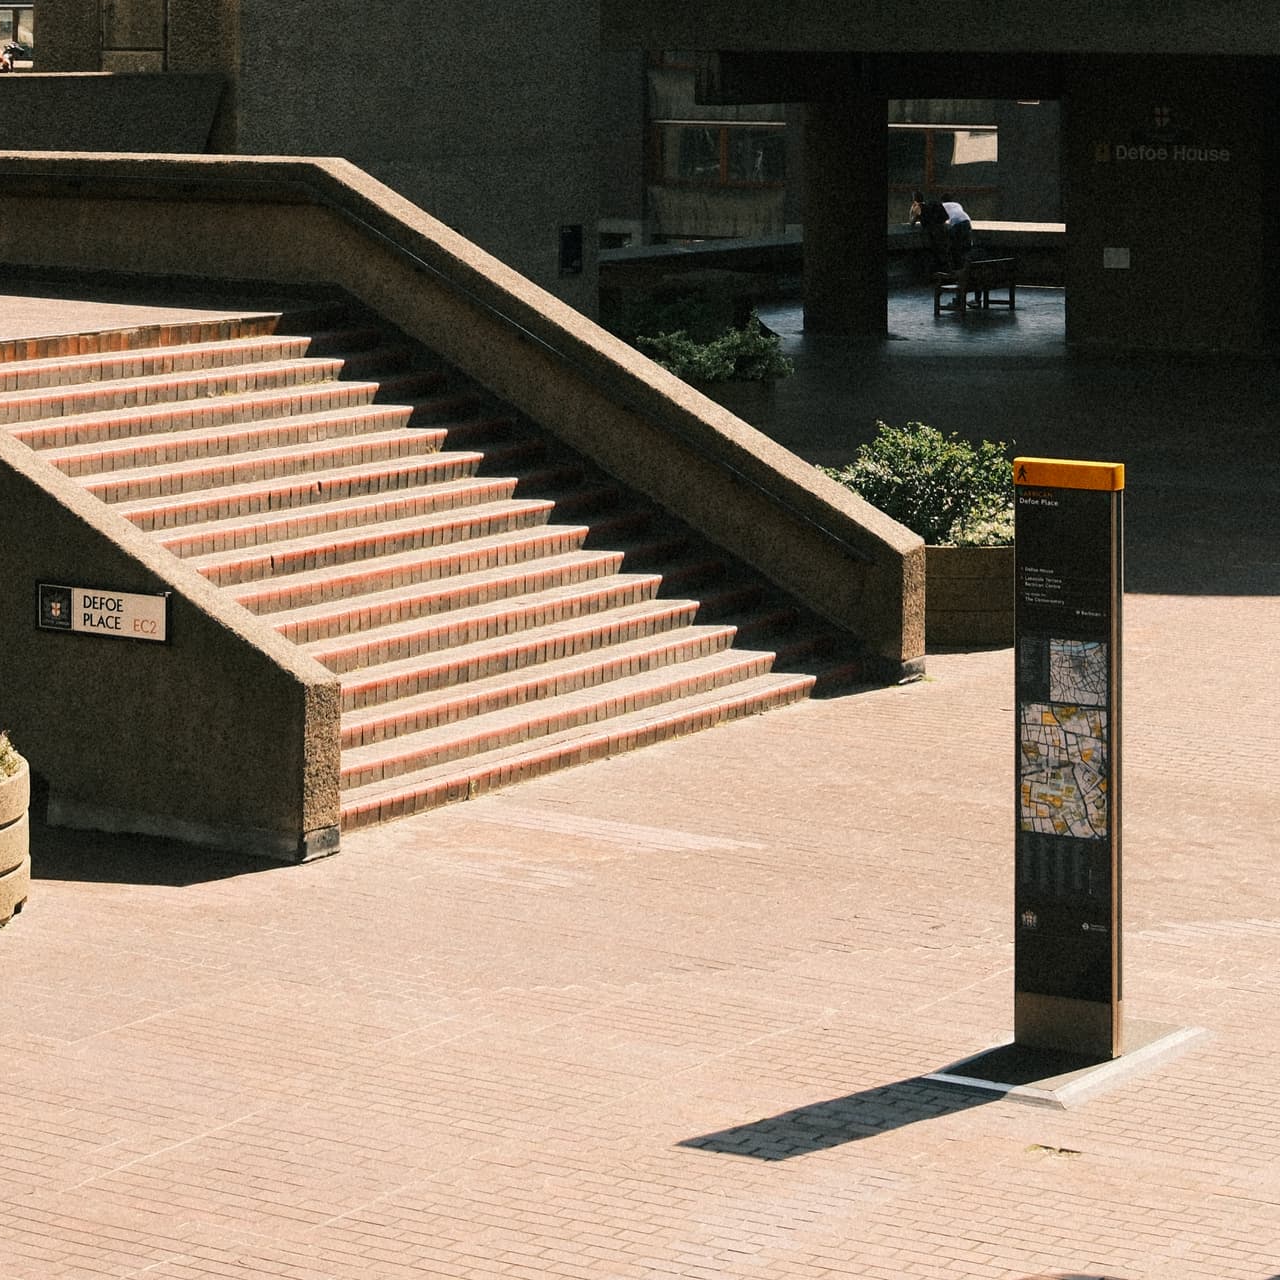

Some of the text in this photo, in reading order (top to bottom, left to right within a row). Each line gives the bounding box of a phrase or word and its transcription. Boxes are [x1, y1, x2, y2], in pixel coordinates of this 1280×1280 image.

[1116, 145, 1230, 162] Defoe House
[1019, 497, 1059, 506] Defoe Place
[83, 595, 124, 612] DEFOE
[83, 613, 122, 630] PLACE
[133, 619, 157, 634] EC2
